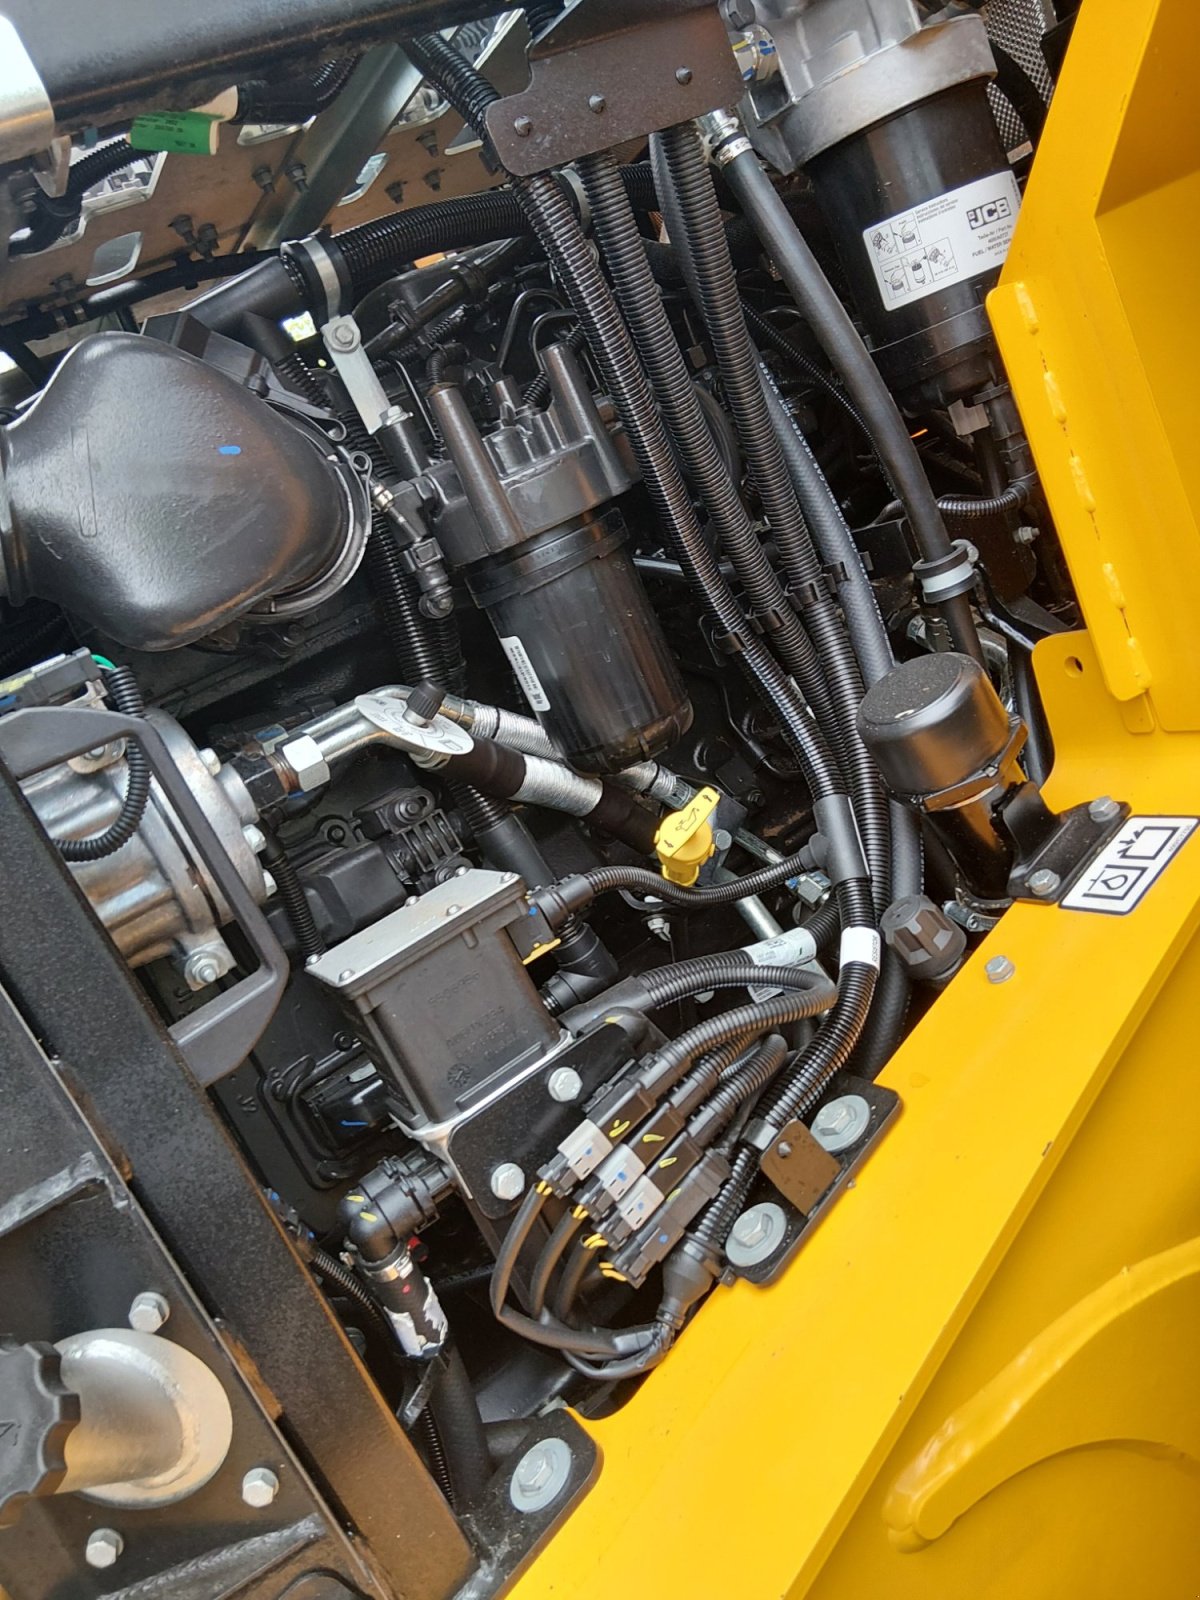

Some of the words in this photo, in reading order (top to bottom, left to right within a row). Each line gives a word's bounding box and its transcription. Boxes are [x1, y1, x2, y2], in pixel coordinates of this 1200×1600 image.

[967, 197, 1010, 229] JCB
[759, 362, 779, 395] WATER
[813, 462, 826, 481] CAR
